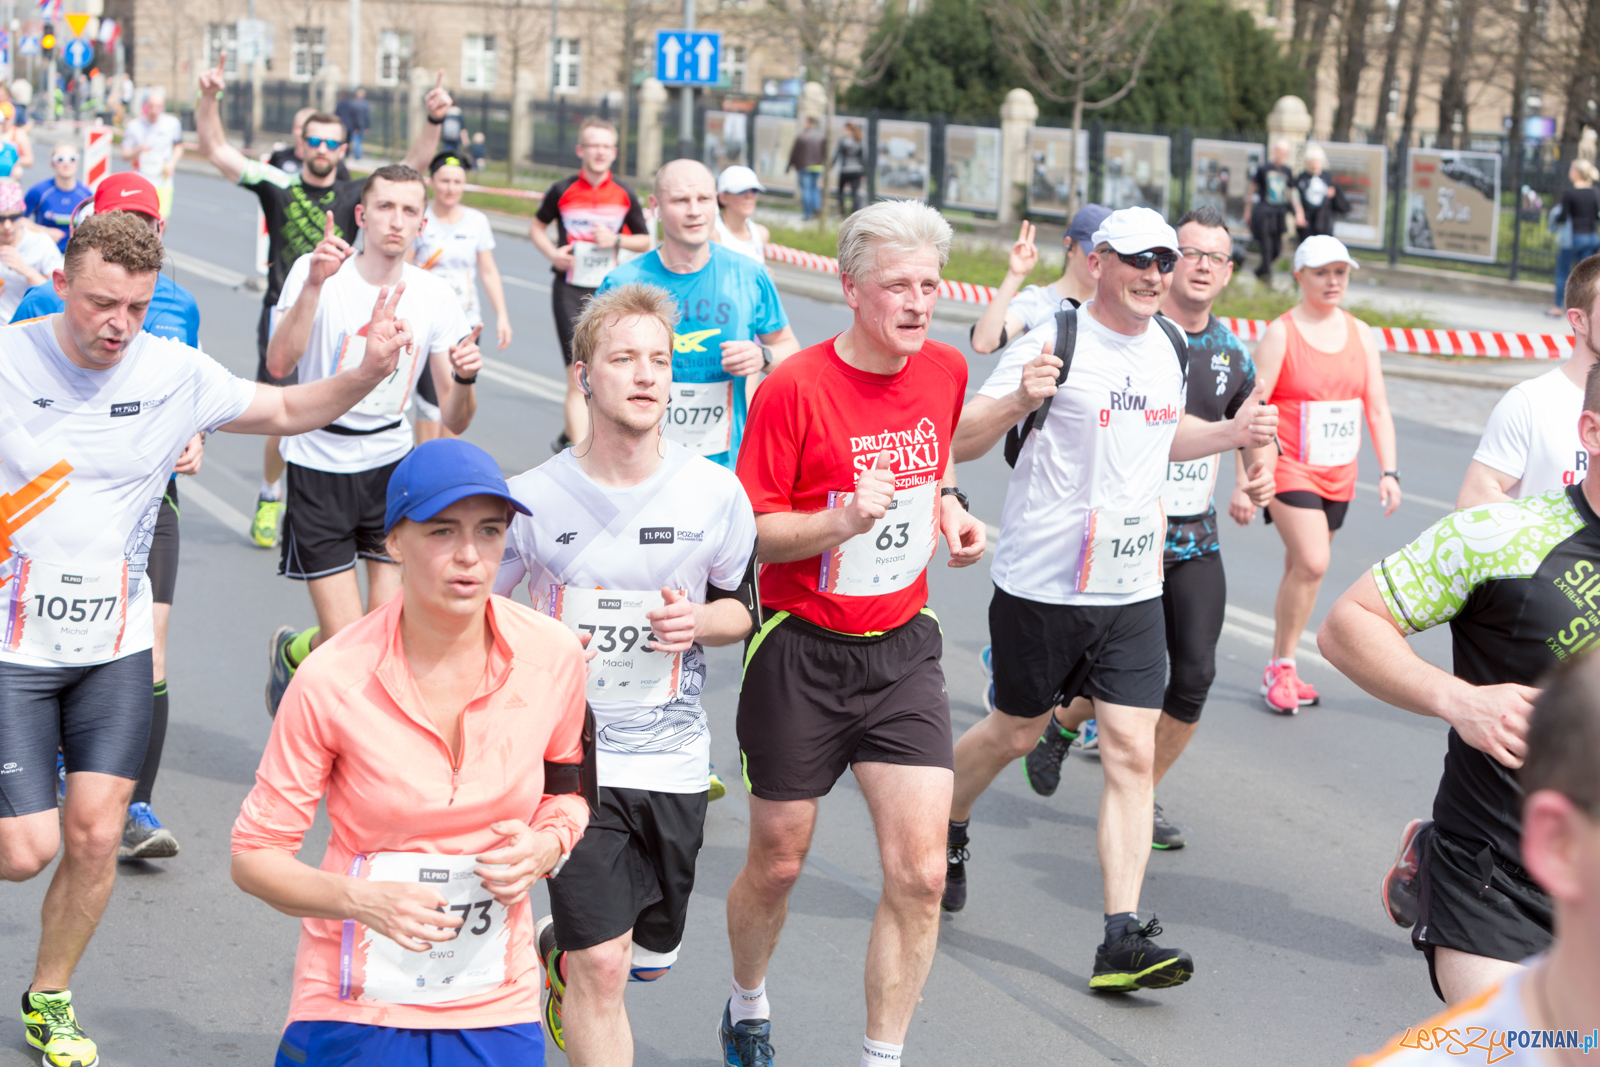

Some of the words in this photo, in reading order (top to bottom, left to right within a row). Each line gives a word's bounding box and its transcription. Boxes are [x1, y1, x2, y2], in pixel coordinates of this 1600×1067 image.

[684, 299, 731, 325] ICS
[33, 398, 54, 409] 4F
[667, 406, 724, 425] 10779
[1322, 420, 1355, 438] 1763
[850, 429, 925, 452] DRUŻYNA
[1166, 463, 1209, 481] 1340
[555, 532, 578, 544] 4F
[876, 522, 909, 550] 63
[1112, 531, 1154, 558] 1491
[875, 554, 905, 565] Ryszard
[1553, 577, 1585, 610] EXTREME
[1565, 560, 1600, 614] SIŁ
[34, 594, 117, 622] 10577
[60, 627, 88, 635] Michał
[578, 624, 659, 652] 7393
[602, 659, 634, 668] Maciej
[429, 951, 454, 959] ewa
